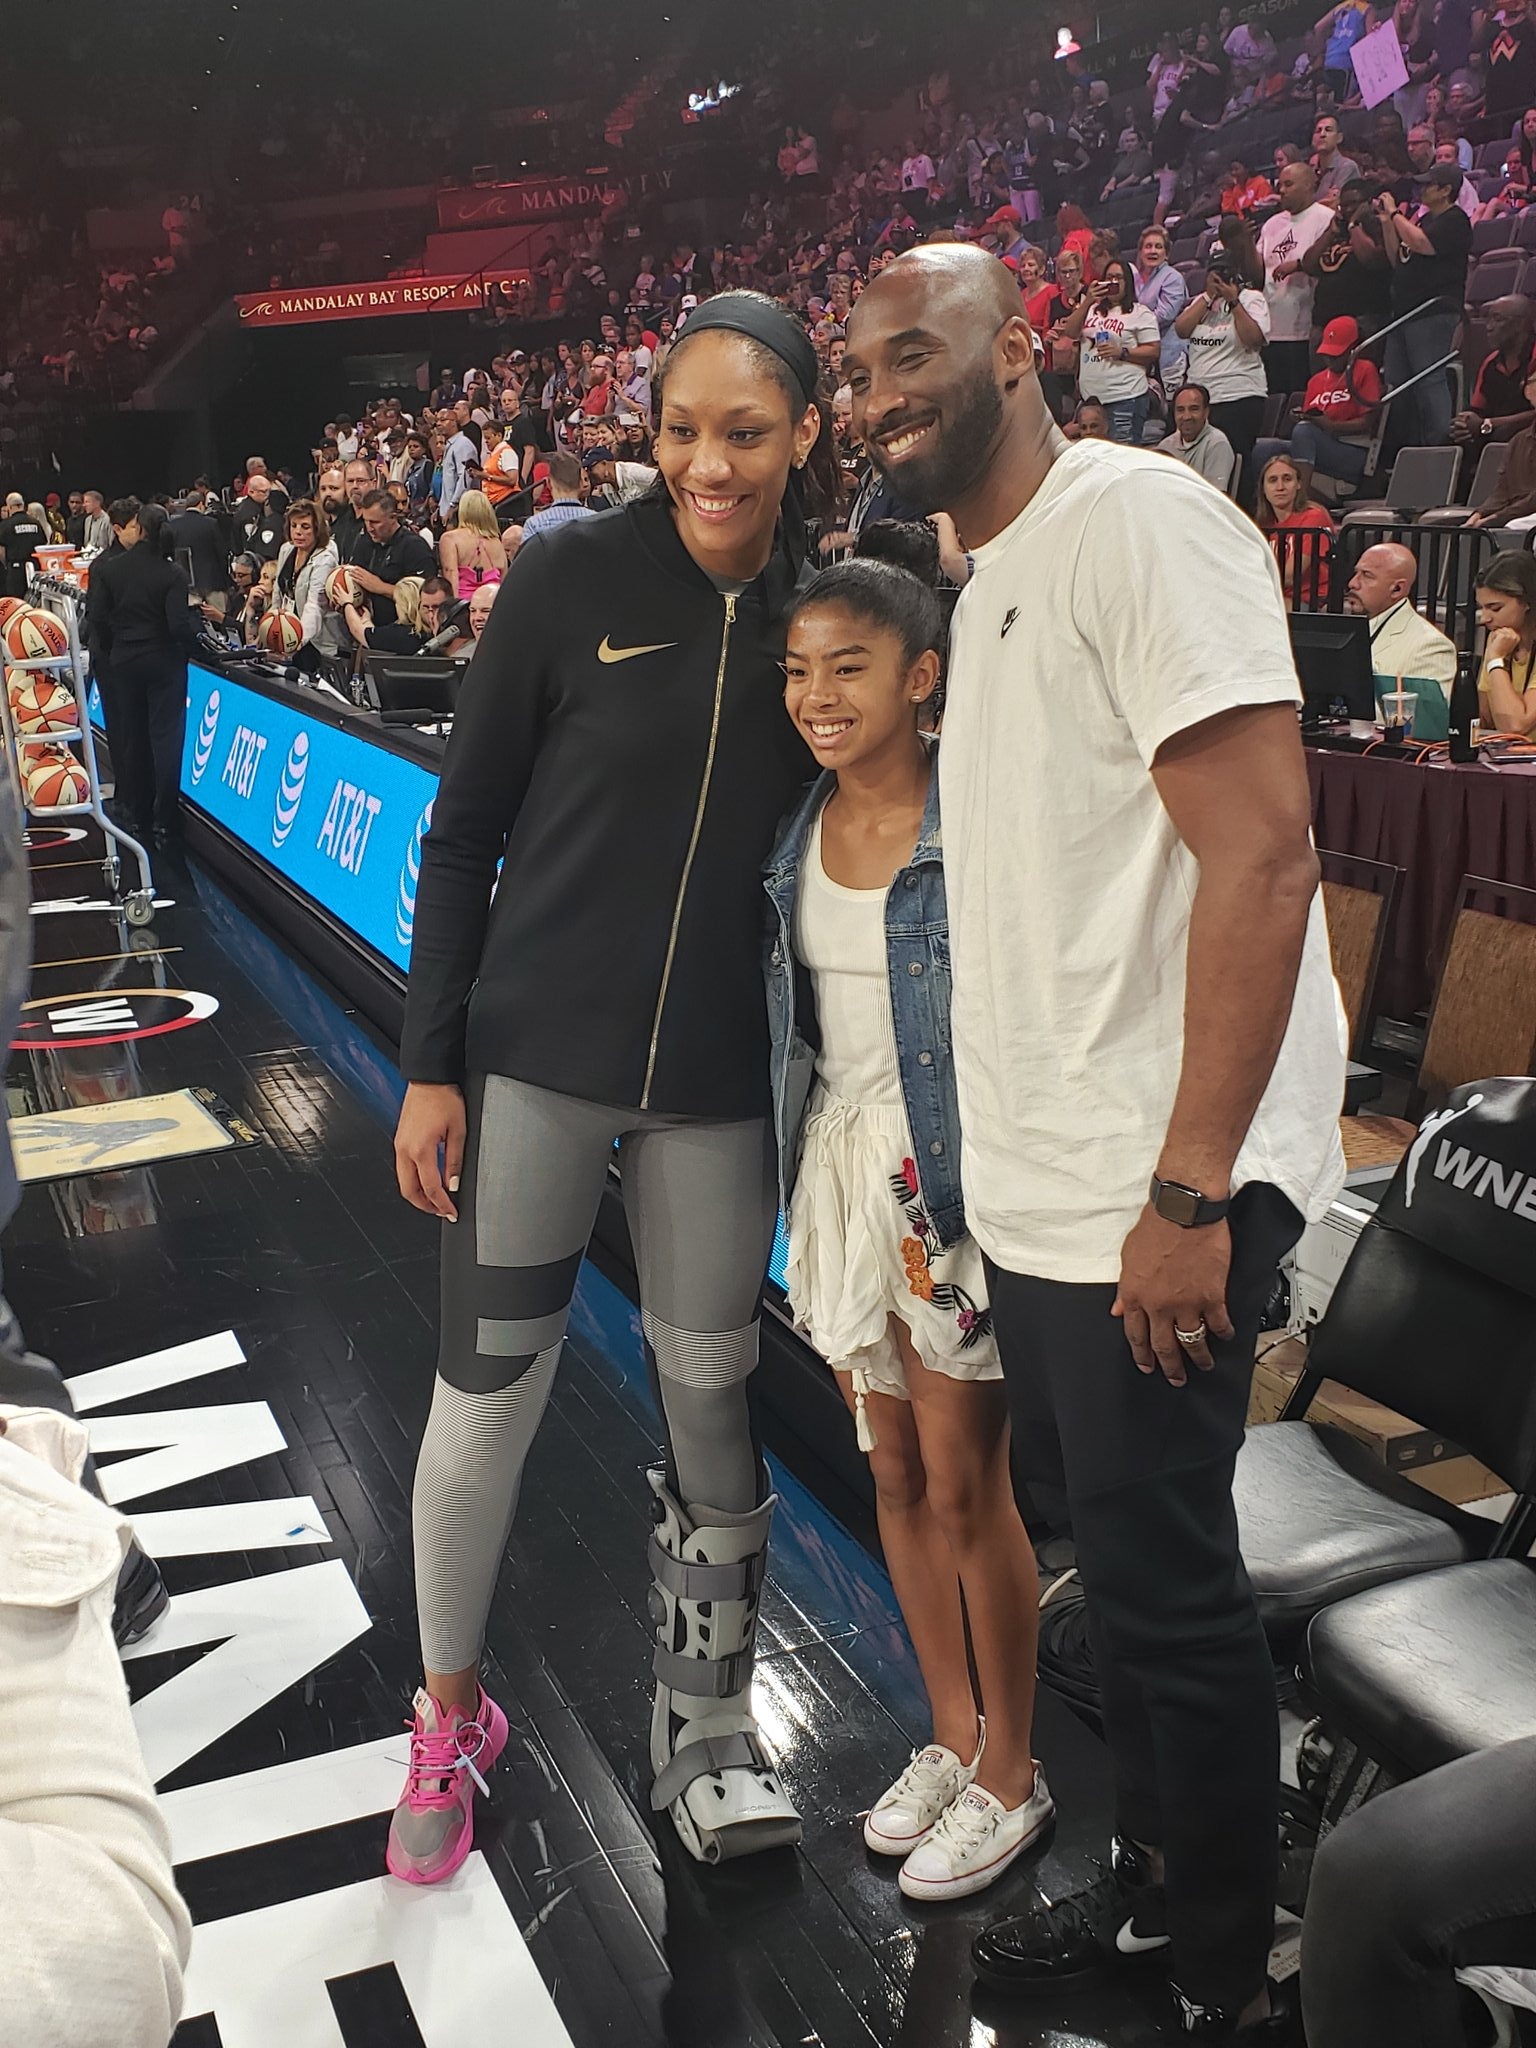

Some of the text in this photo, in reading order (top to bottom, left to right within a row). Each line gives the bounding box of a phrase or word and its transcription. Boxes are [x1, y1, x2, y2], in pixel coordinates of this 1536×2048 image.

[280, 293, 364, 313] MANDALAY
[370, 290, 397, 306] BAY
[403, 284, 457, 303] RESORT
[463, 281, 493, 297] AND
[1309, 388, 1351, 406] ACES
[14, 524, 39, 534] SECURITY
[222, 725, 268, 800] AT&T
[316, 779, 382, 876] AT&T
